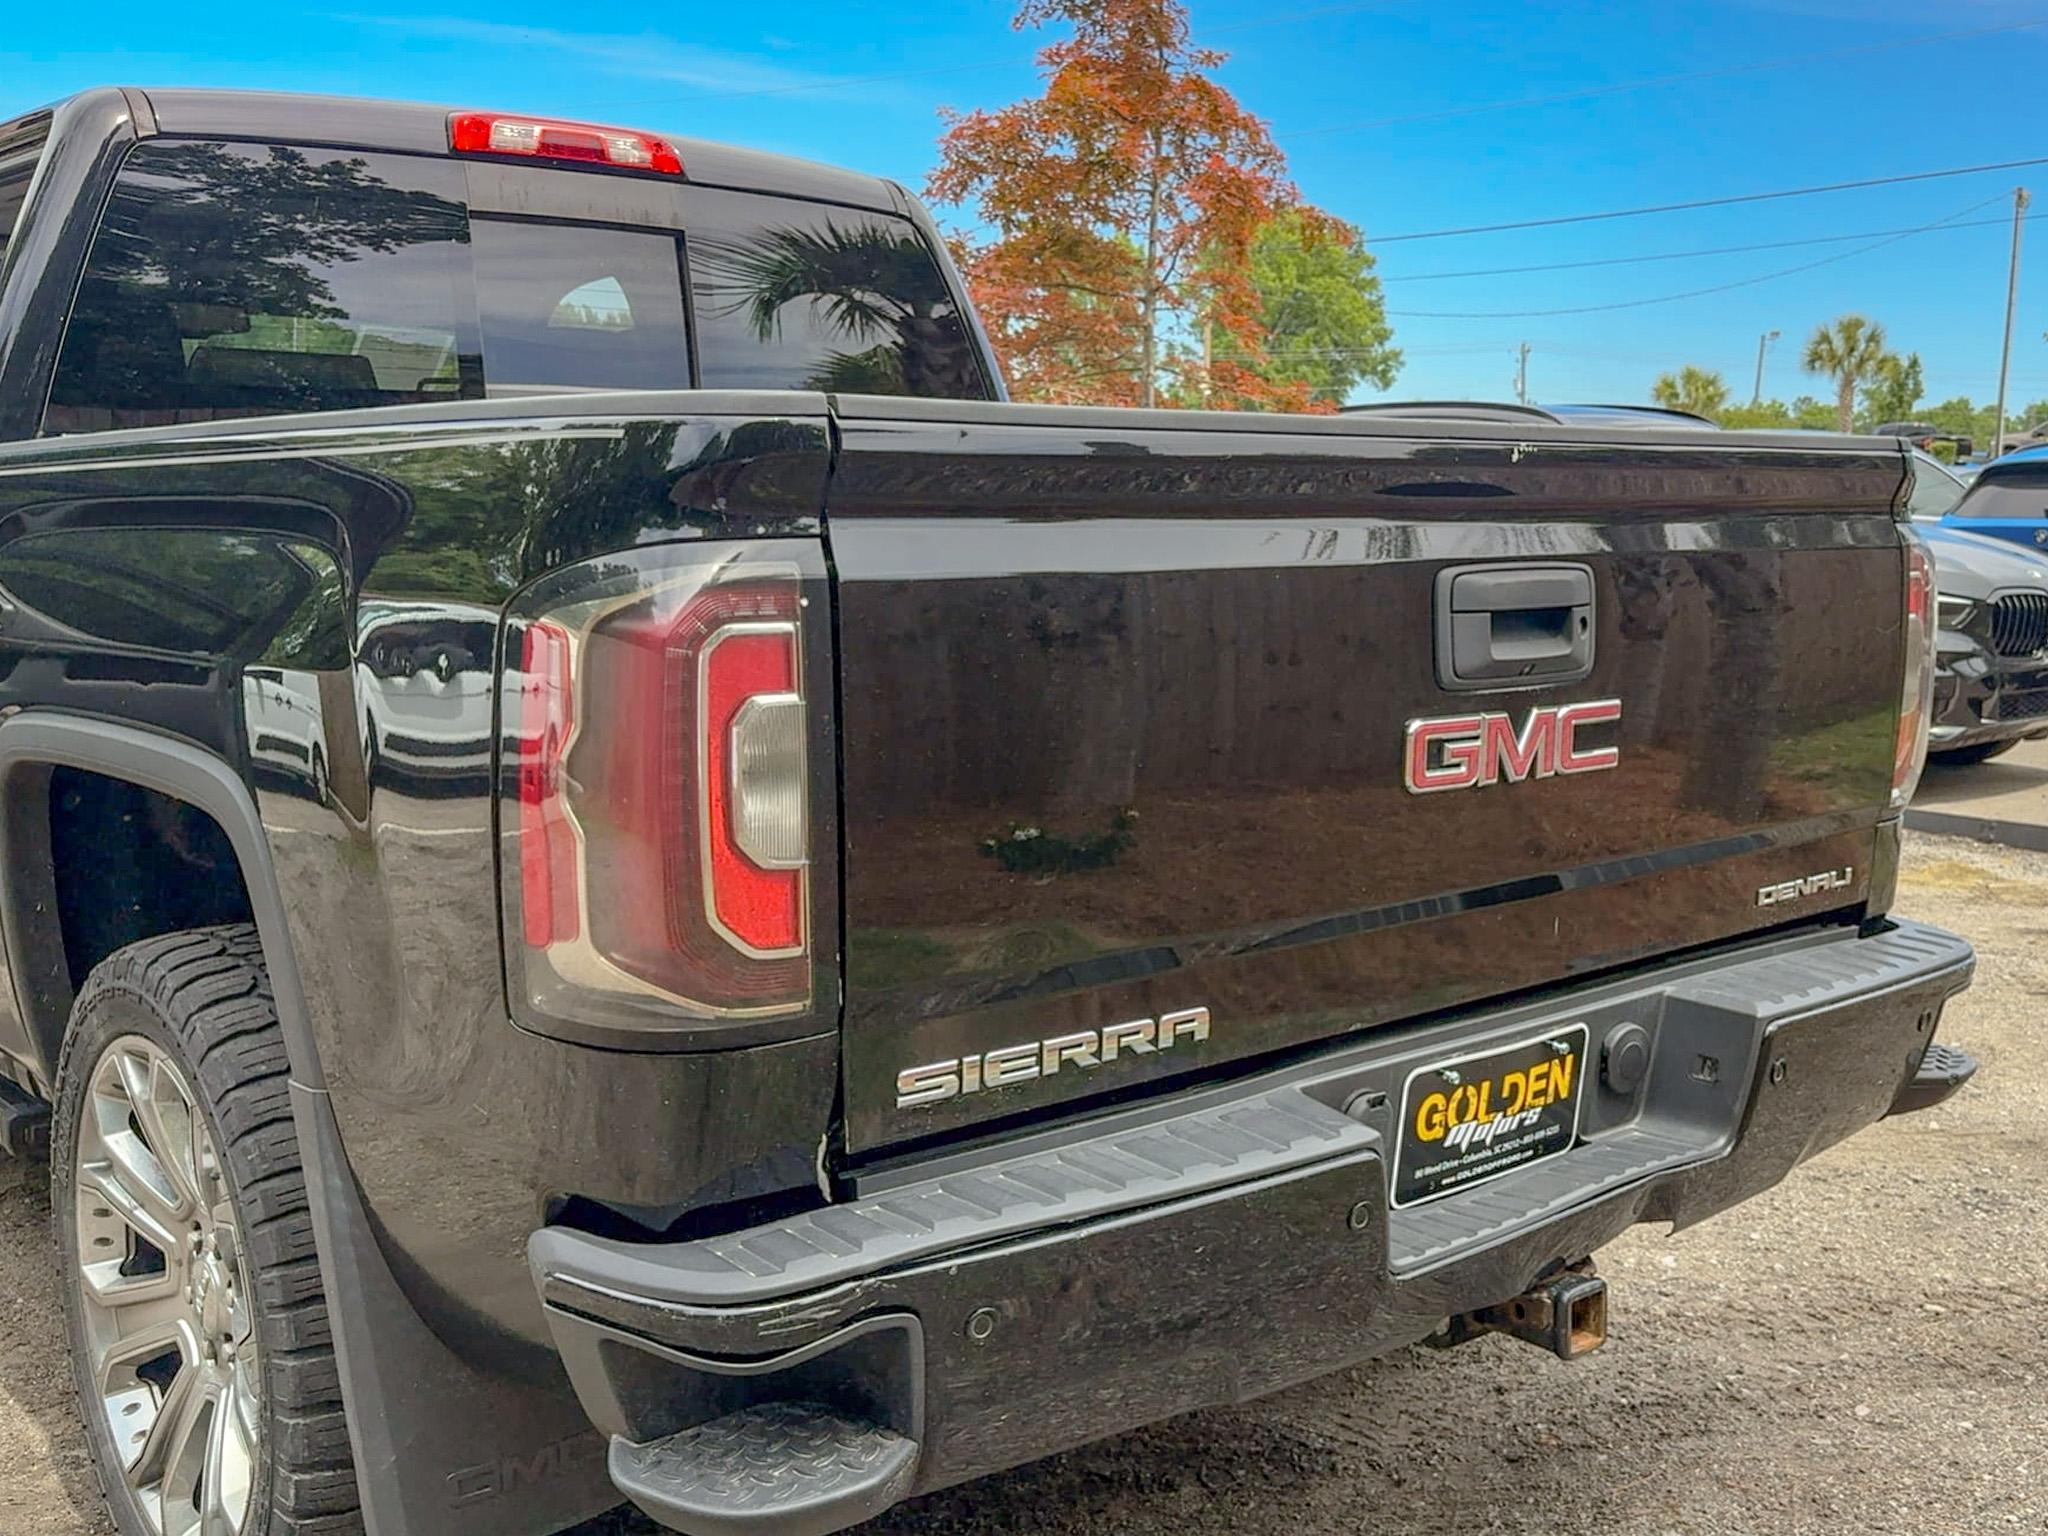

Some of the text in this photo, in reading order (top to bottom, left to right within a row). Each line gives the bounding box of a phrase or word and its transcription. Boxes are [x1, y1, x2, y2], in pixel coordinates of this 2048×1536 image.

[1405, 699, 1622, 795] GMC
[1756, 866, 1853, 907] DENALI
[896, 1006, 1211, 1109] SIERRA
[1416, 1053, 1575, 1143] GOLDEN
